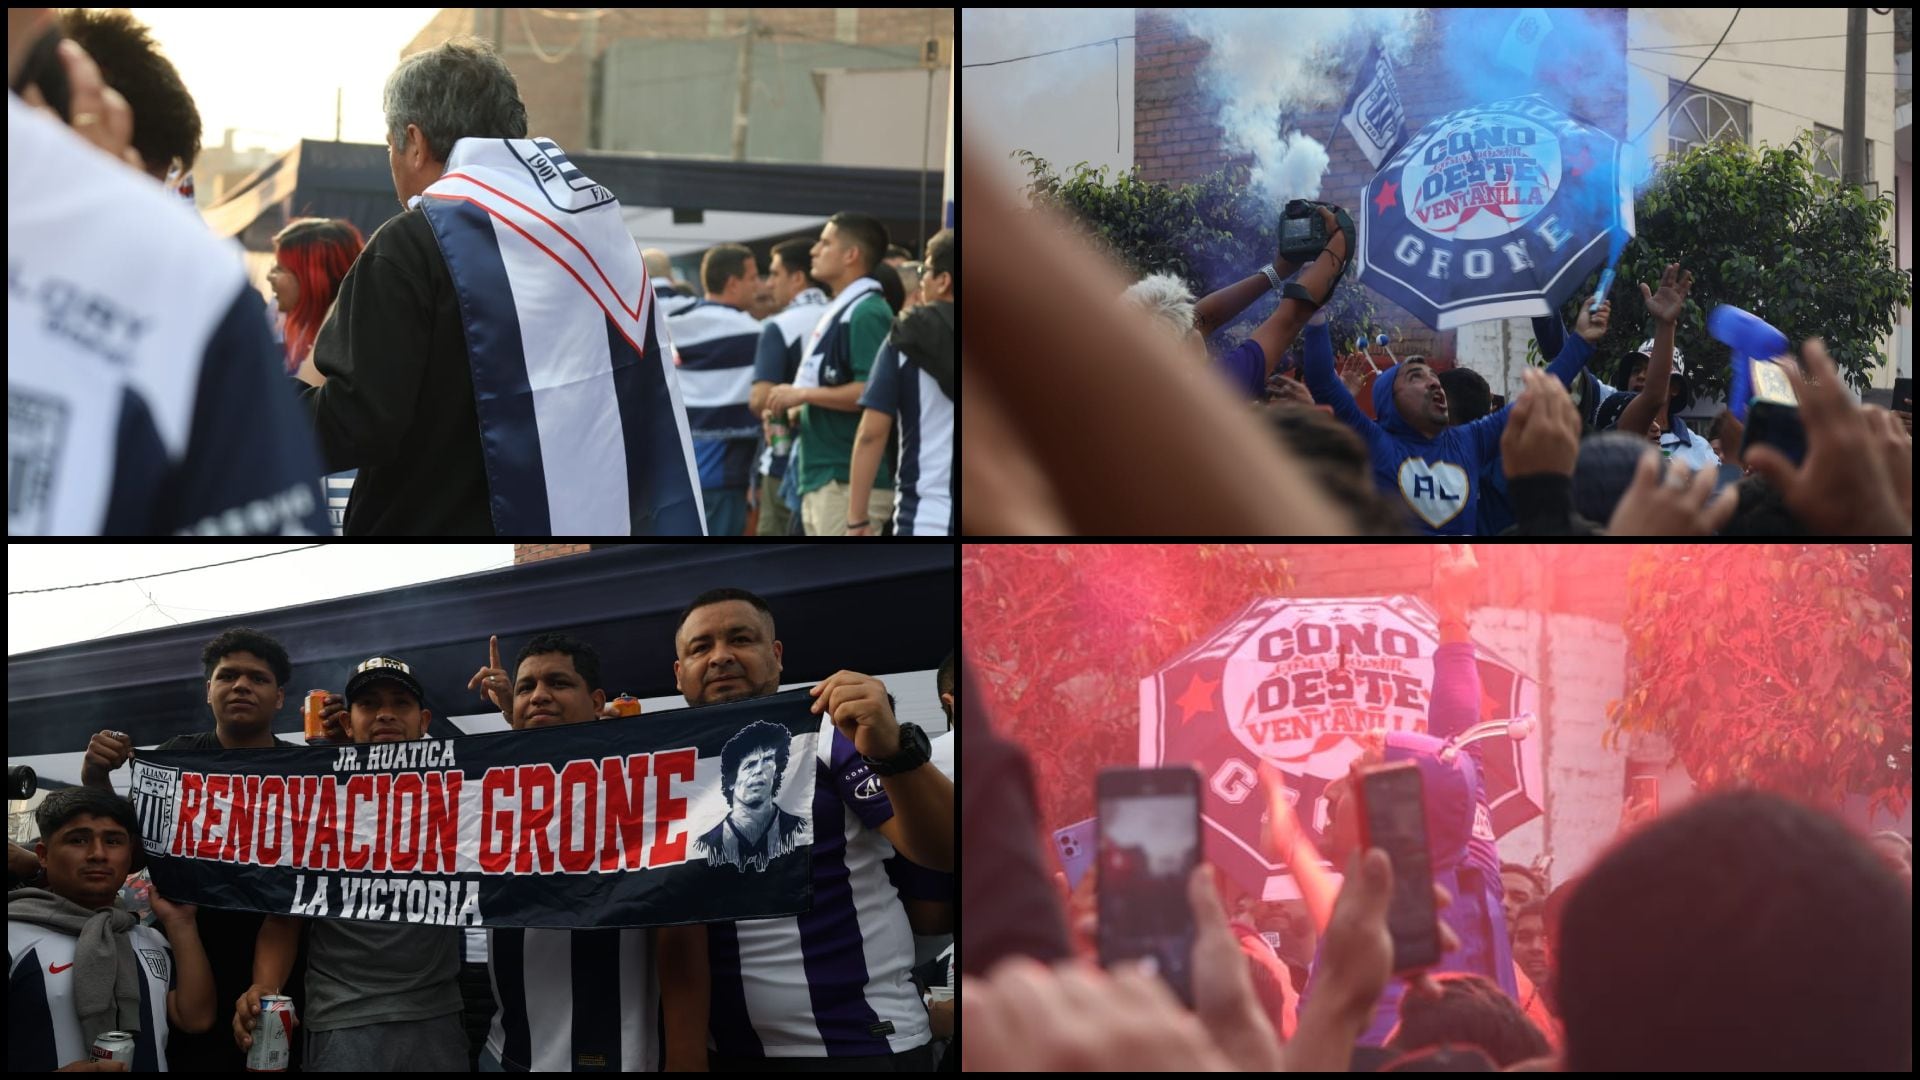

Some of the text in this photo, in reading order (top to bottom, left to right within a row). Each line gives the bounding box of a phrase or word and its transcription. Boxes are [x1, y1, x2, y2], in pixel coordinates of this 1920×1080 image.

[1423, 126, 1537, 166] CONO
[527, 152, 558, 184] 1901
[1422, 158, 1538, 202] OESTE
[1414, 183, 1545, 224] VENTANILLA
[1394, 214, 1575, 280] GRONE
[1414, 473, 1460, 500] AL
[1257, 622, 1420, 664] CONO
[1256, 668, 1425, 715] OESTE
[141, 766, 173, 782] ALIANZA
[332, 739, 456, 772] JR. HUATICA
[163, 795, 173, 829] LIMA
[171, 746, 699, 875] RENOVACION GRONE
[143, 840, 158, 851] 901
[290, 874, 484, 927] LA VICTORIA
